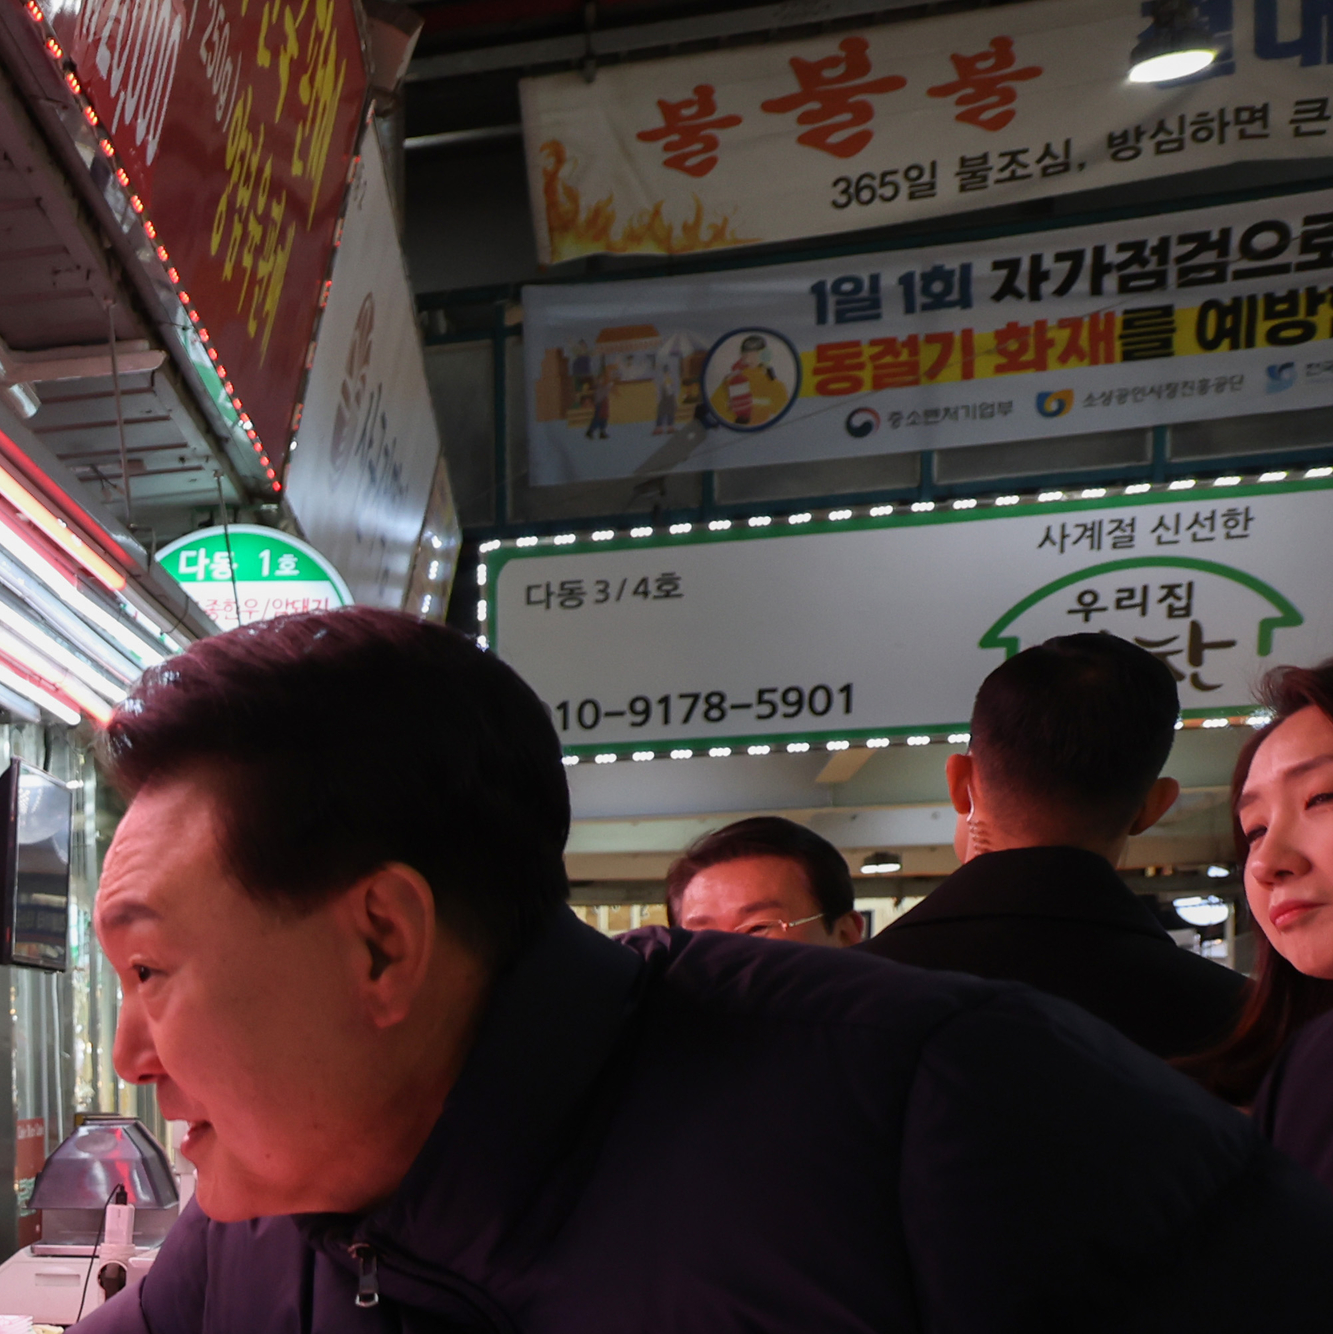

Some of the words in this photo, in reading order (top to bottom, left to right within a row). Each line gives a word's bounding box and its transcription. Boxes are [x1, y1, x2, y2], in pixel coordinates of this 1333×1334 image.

[635, 83, 742, 177] 불
[761, 35, 908, 158] 불
[927, 33, 1044, 132] 불
[830, 158, 938, 211] 365일
[954, 137, 1087, 195] 불조심,
[1106, 101, 1271, 163] 방심하면
[809, 273, 882, 325] 1일
[897, 262, 973, 313] 1회
[812, 327, 975, 397] 동절기
[993, 302, 1179, 373] 화재를
[1194, 283, 1333, 352] 예방
[1037, 514, 1141, 554] 사계절
[1149, 505, 1256, 548] 신선한
[178, 547, 238, 581] 다동
[524, 579, 588, 610] 다동
[1066, 580, 1196, 624] 우리집
[555, 681, 856, 733] 10-9178-5901
